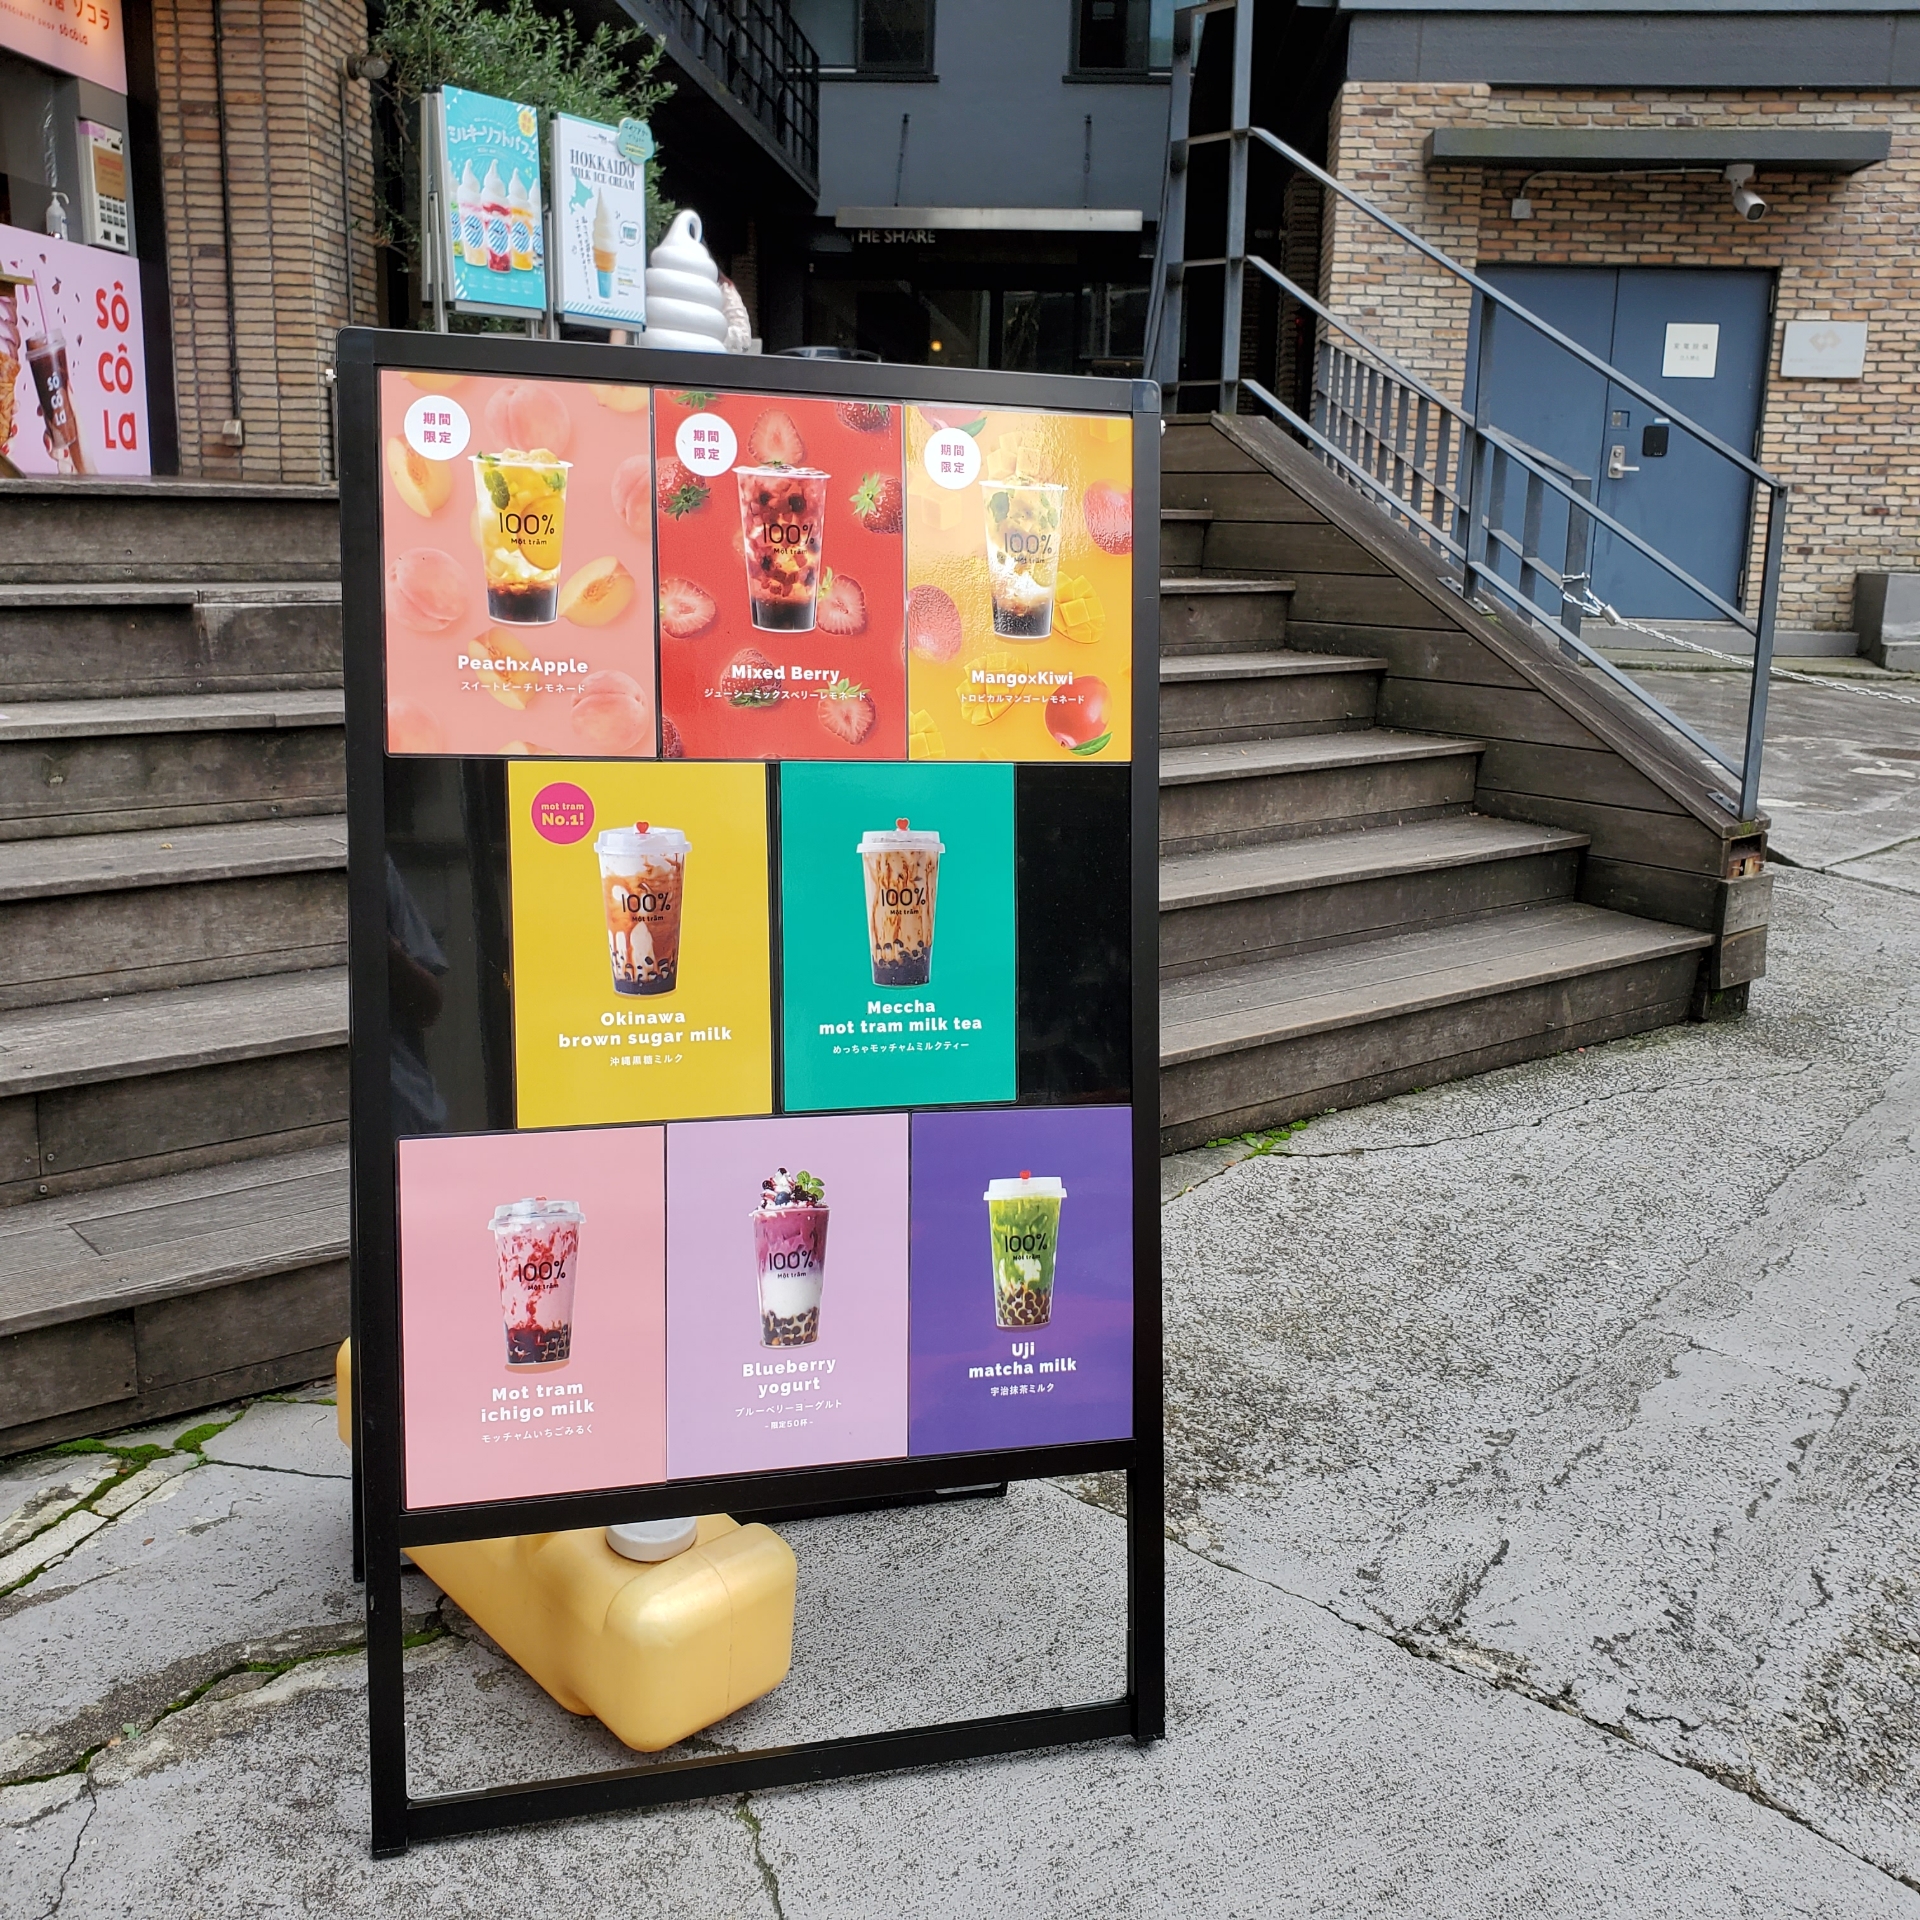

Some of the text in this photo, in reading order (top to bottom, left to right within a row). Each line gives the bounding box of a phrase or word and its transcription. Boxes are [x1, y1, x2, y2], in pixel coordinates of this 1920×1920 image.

[570, 148, 635, 179] HOKKAIDO
[570, 165, 635, 191] MILK ICE CREAM
[850, 229, 936, 244] HE SHARE
[422, 411, 452, 427] 期間
[423, 430, 453, 444] 限定
[693, 429, 720, 444] 期間
[694, 448, 721, 461] 限定
[941, 444, 965, 457] 期間
[941, 461, 965, 474] 限定
[499, 512, 555, 535] 100%
[763, 523, 815, 545] 100%
[1005, 533, 1053, 555] 100%
[732, 664, 840, 683] Mixed Berry
[461, 681, 585, 693] スイートピーチレモネード
[541, 802, 585, 811] mot tram
[542, 812, 585, 827] No.1!
[622, 892, 671, 913] 100%
[882, 887, 926, 907] 100%
[867, 1000, 936, 1016] Meccha
[601, 1011, 686, 1027] Okinawa
[819, 1017, 983, 1035] mot tram milk tea
[559, 1027, 733, 1048] brown sugar milk
[832, 1041, 970, 1055] めっちゃモッチャムミルクティー
[610, 1053, 684, 1067] 沖縄黒糖ミルク
[1005, 1232, 1048, 1252] 100%
[519, 1258, 566, 1282] 100%
[769, 1250, 814, 1271] 100%
[1011, 1342, 1035, 1358] Uji
[742, 1357, 837, 1378] Blueberry
[969, 1357, 1077, 1379] matcha milk
[492, 1383, 583, 1402] Mot tram
[758, 1377, 821, 1399] yogurt
[990, 1382, 1055, 1397] 宇治抹茶ミルク
[481, 1398, 595, 1424] ichigo milk
[735, 1399, 843, 1418] ブルーベリーヨーグルト
[481, 1424, 594, 1444] モッチャムいちごみるく
